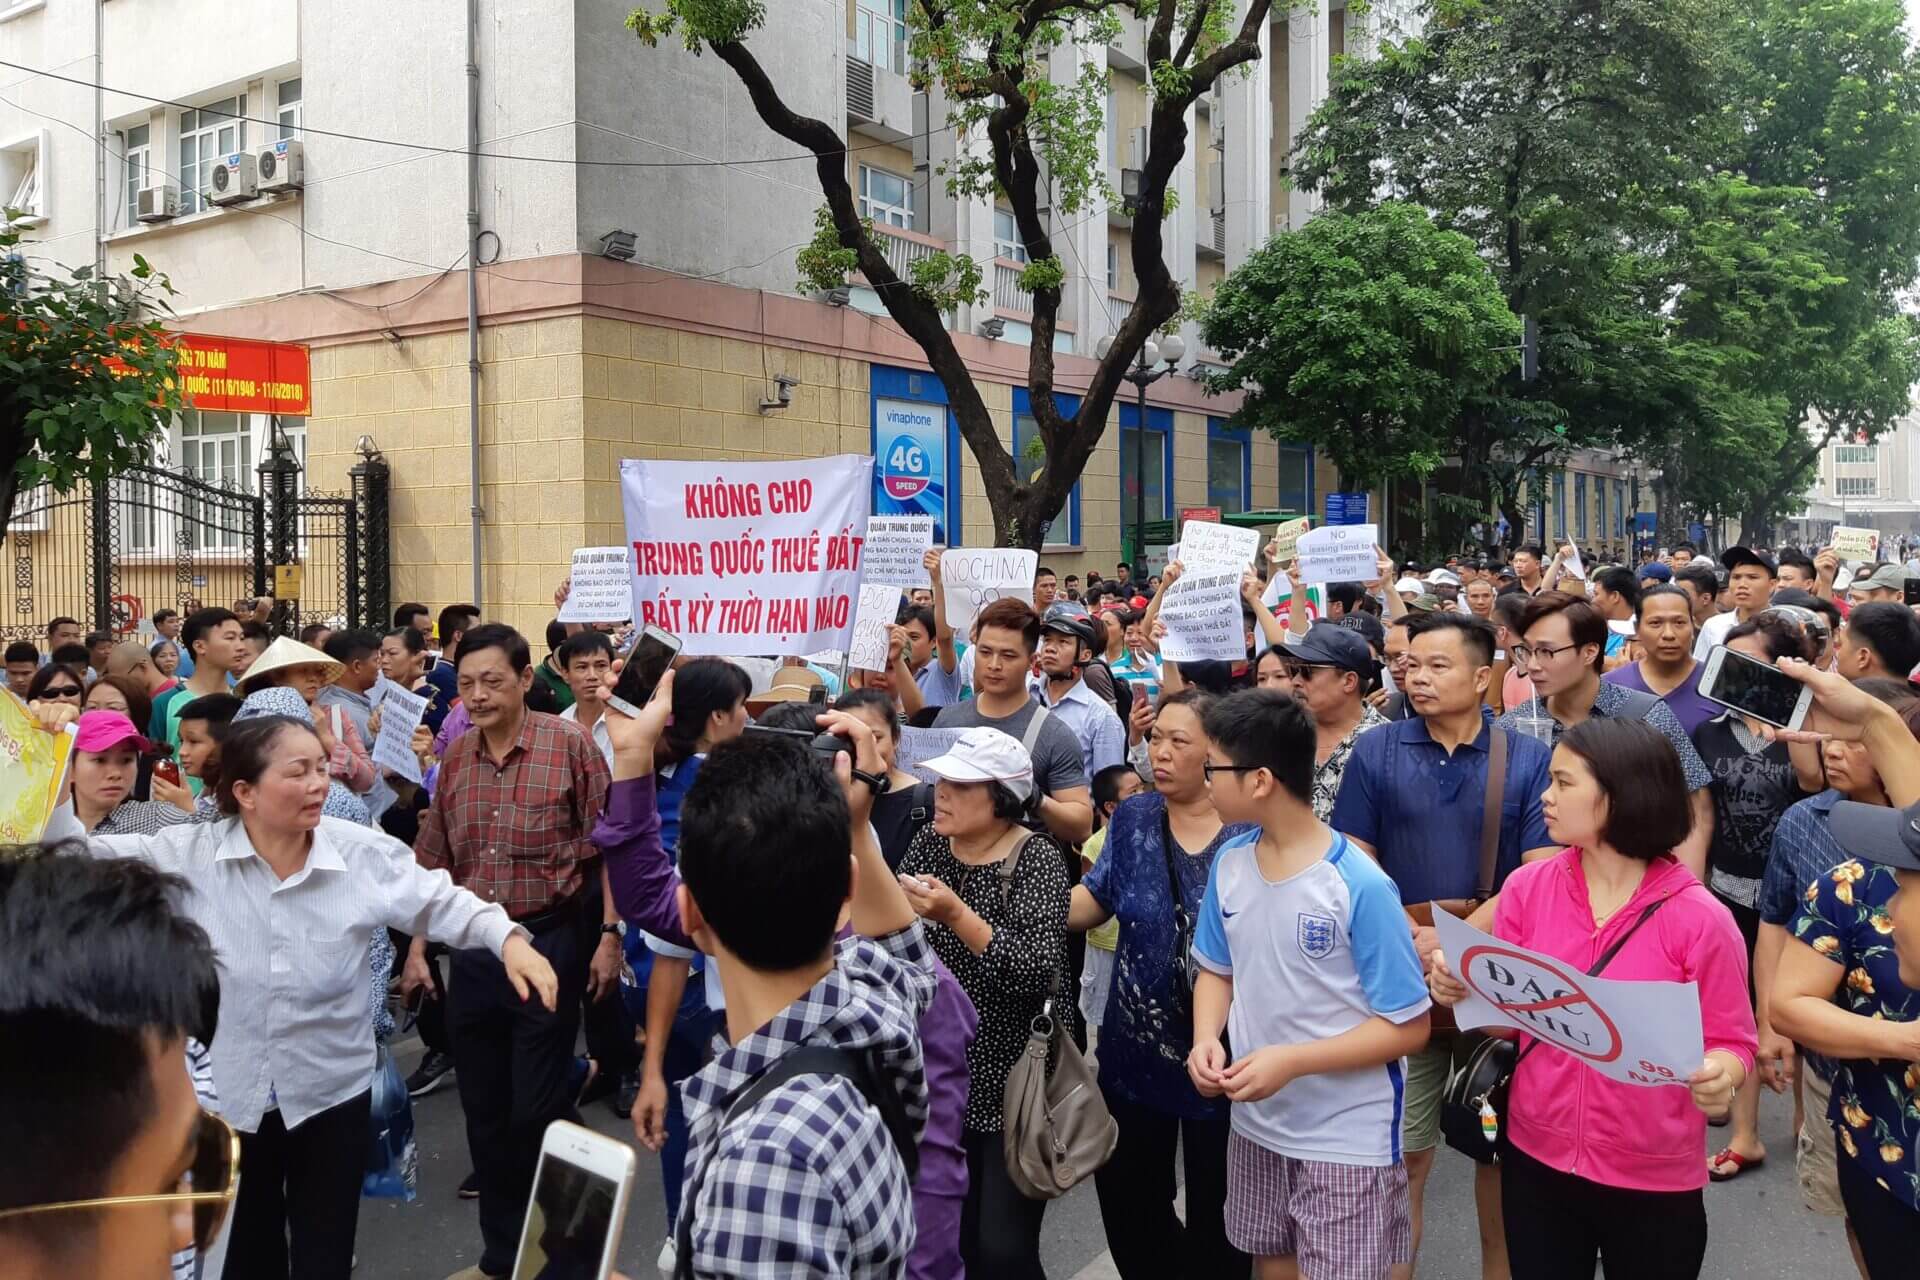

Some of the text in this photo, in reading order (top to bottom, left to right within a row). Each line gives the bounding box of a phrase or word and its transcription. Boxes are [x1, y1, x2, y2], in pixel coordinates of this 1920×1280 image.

[195, 351, 205, 367] 70
[207, 349, 227, 369] NĂM
[187, 372, 210, 394] QUỐC
[212, 377, 255, 397] (11/6/1948
[262, 382, 302, 401] 11/6/2018)
[886, 409, 932, 426] vinaphone
[890, 445, 923, 473] 4G
[895, 481, 918, 491] SPEED
[685, 476, 813, 519] KHÔNG CHO
[888, 522, 909, 532] TRUNG
[1330, 530, 1346, 540] NO
[632, 523, 864, 579] TRUNG QUỐC THUÊ ĐẤT
[1309, 543, 1370, 553] leasing land to
[1310, 553, 1370, 565] China even for
[1198, 575, 1218, 589] TRUNG
[641, 587, 681, 634] BẤT
[688, 593, 715, 634] KỲ
[718, 589, 763, 634] THỜI
[766, 598, 808, 642] HẠN
[1484, 958, 1584, 1015] ĐẶC
[1638, 1059, 1675, 1078] 99
